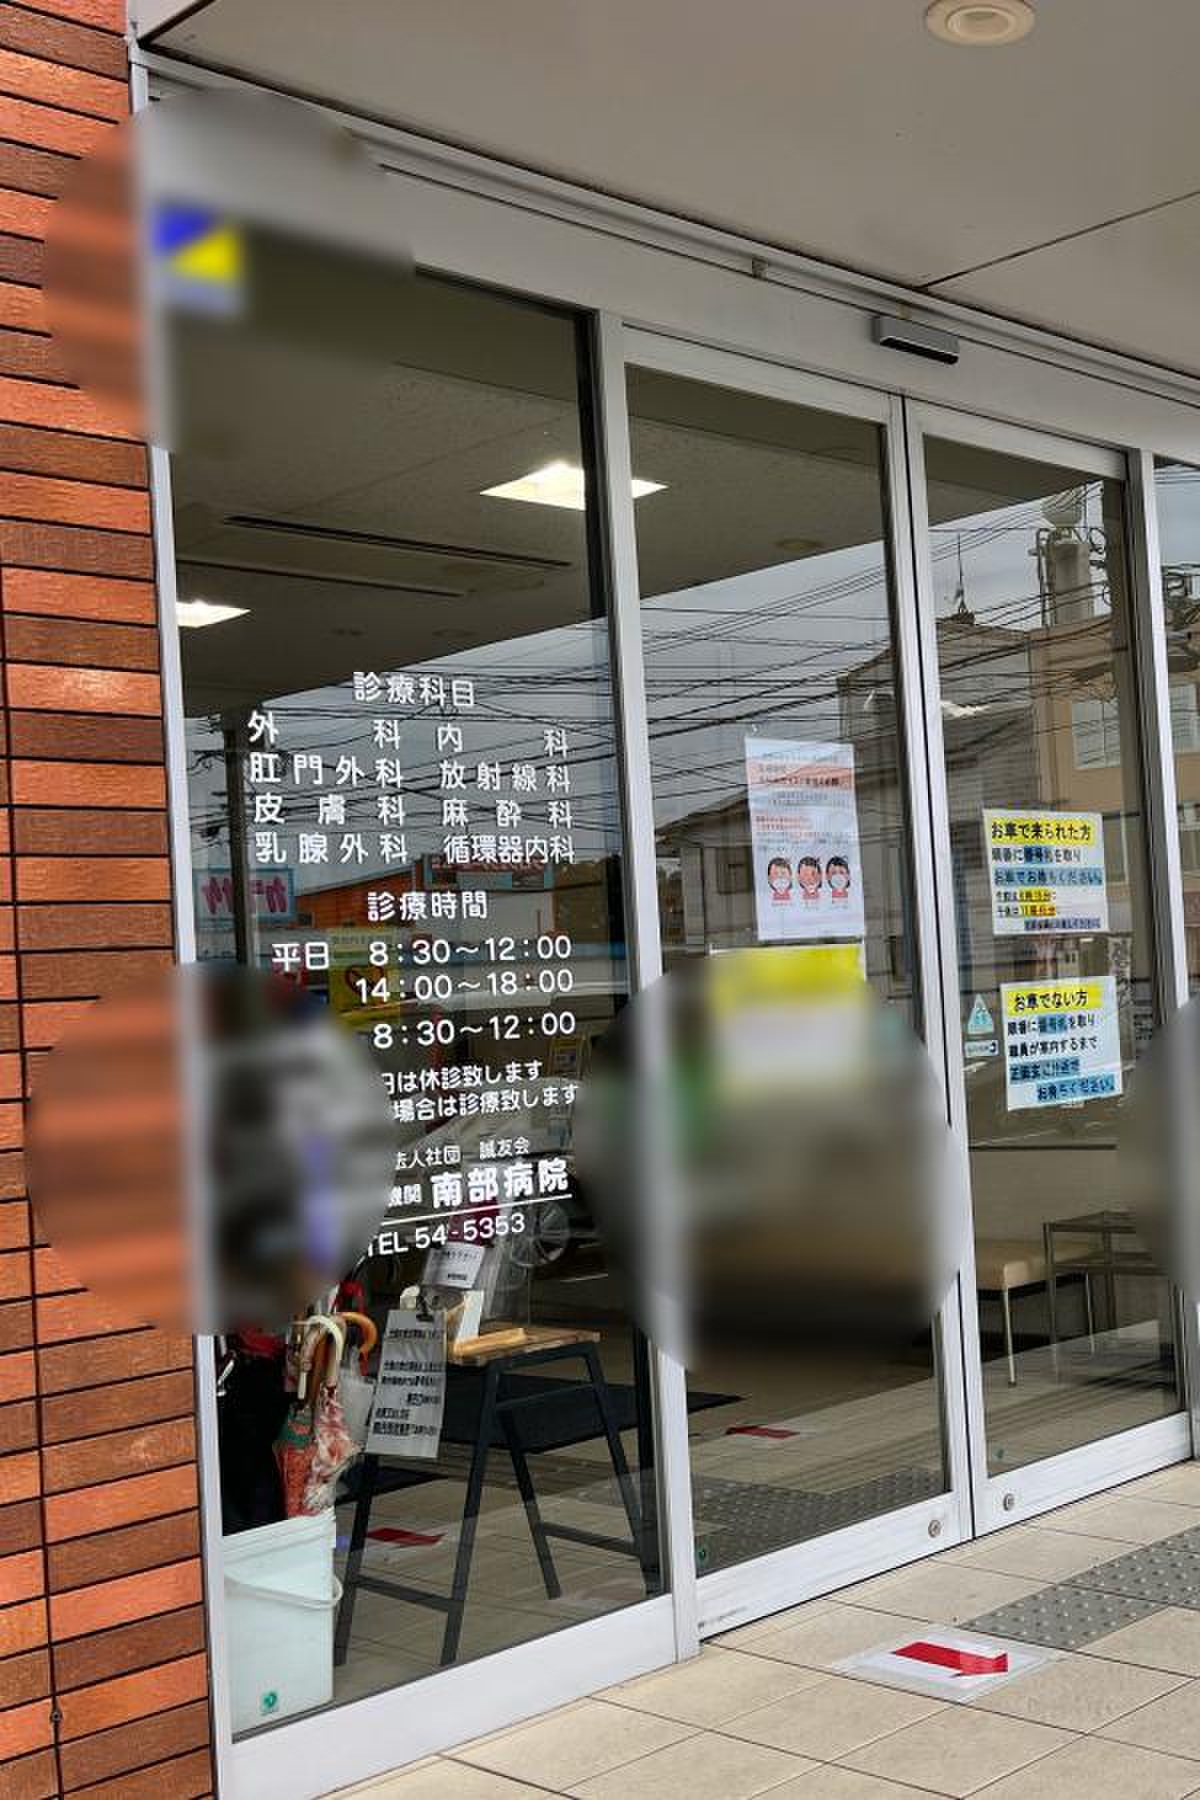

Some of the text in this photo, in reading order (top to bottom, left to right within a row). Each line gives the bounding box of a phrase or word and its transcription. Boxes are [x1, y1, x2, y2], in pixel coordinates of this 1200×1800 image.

[353, 672, 475, 707] 診療科目
[250, 754, 571, 793] 肛門外科 放射線科
[254, 794, 573, 829] 皮膚科 麻酔科
[991, 822, 1091, 840] お車で来られた方
[256, 832, 575, 865] 乳腺外科 循環器内科
[367, 891, 488, 921] 診療時間
[271, 942, 329, 973] 平日
[1014, 990, 1088, 1012] お車でない方
[429, 1157, 569, 1209] 南部病院
[416, 1211, 526, 1249] 54-5353
